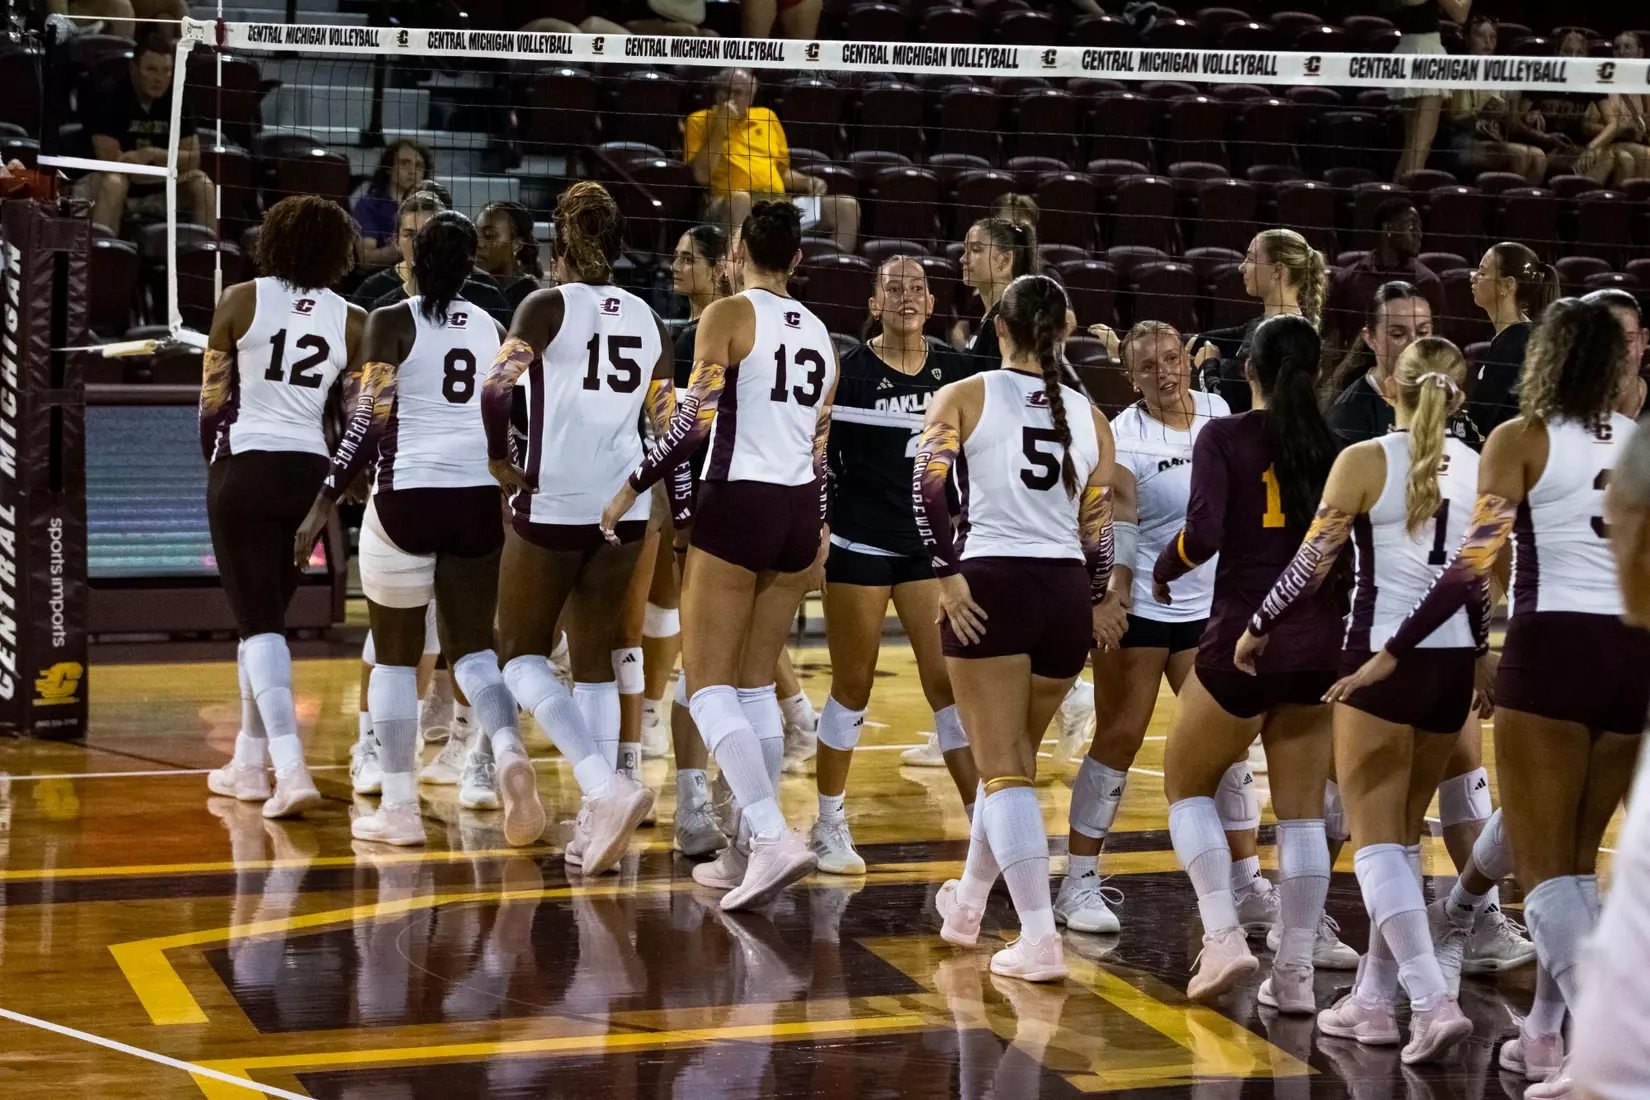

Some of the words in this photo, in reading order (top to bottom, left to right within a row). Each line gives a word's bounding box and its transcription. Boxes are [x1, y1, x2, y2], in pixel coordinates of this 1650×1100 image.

[248, 25, 282, 43] CENTRAL
[285, 26, 326, 45] MICHIGAN
[328, 27, 380, 47] VOLLEYBALL
[427, 31, 466, 50] CENTRAL
[469, 32, 514, 52] MICHIGAN
[517, 34, 573, 54] VOLLEYBALL
[625, 37, 667, 57] CENTRAL
[670, 38, 720, 59] MICHIGAN
[723, 40, 785, 61] VOLLEYBALL
[842, 43, 889, 65] CENTRAL
[892, 45, 947, 67] MICHIGAN
[951, 47, 1019, 69] VOLLEYBALL
[1081, 49, 1134, 72] CENTRAL
[1138, 50, 1198, 74] MICHIGAN
[1202, 53, 1277, 76] VOLLEYBALL
[1349, 56, 1406, 79] CENTRAL
[1411, 57, 1480, 81] MICHIGAN
[1483, 59, 1567, 83] VOLLEYBALL
[0, 240, 21, 480] MICHIGAN
[264, 328, 331, 389] 12
[442, 348, 477, 404] 8
[583, 333, 642, 393] 15
[770, 343, 826, 407] 13
[333, 396, 374, 470] CHIPPEWAS
[1020, 426, 1063, 491] 5
[47, 517, 65, 575] sports
[0, 504, 17, 701] CENTRAL
[48, 577, 66, 648] imports
